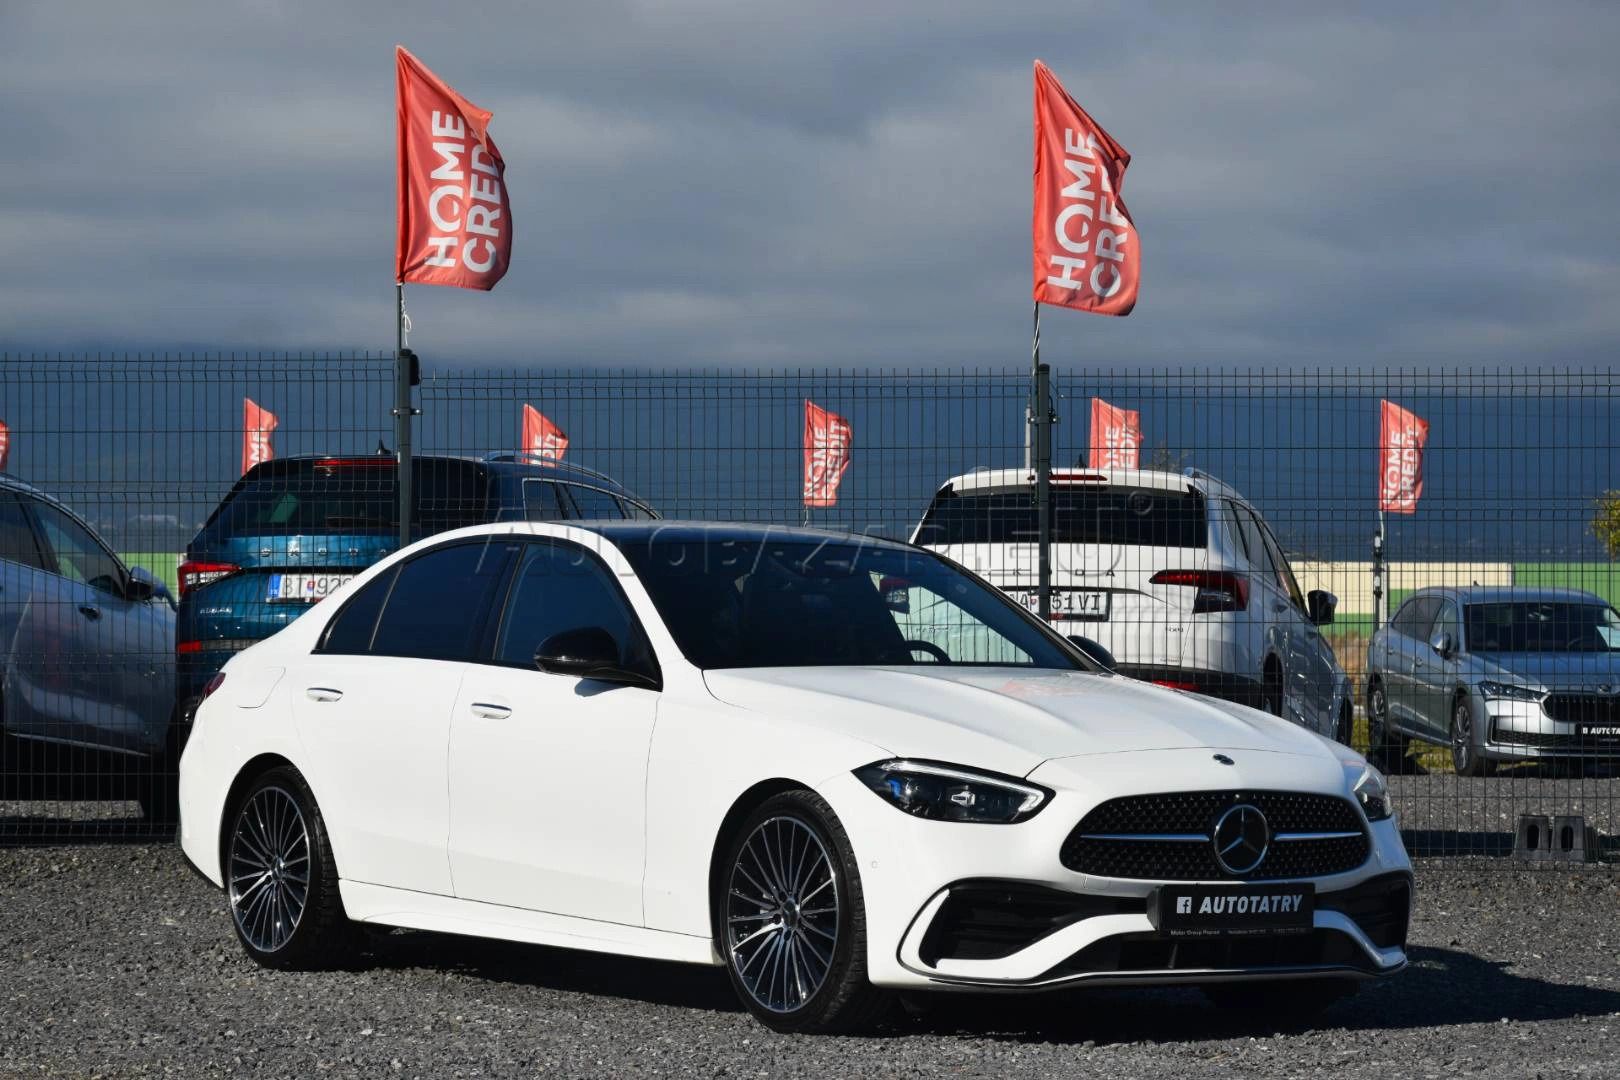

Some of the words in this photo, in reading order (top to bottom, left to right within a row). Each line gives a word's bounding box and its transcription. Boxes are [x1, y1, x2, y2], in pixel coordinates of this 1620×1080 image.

[424, 110, 466, 268] HOME
[462, 129, 501, 274] CRED
[1046, 127, 1098, 291] HOME
[1048, 594, 1102, 611] 51VI
[1199, 895, 1303, 914] AUTOTATRY
